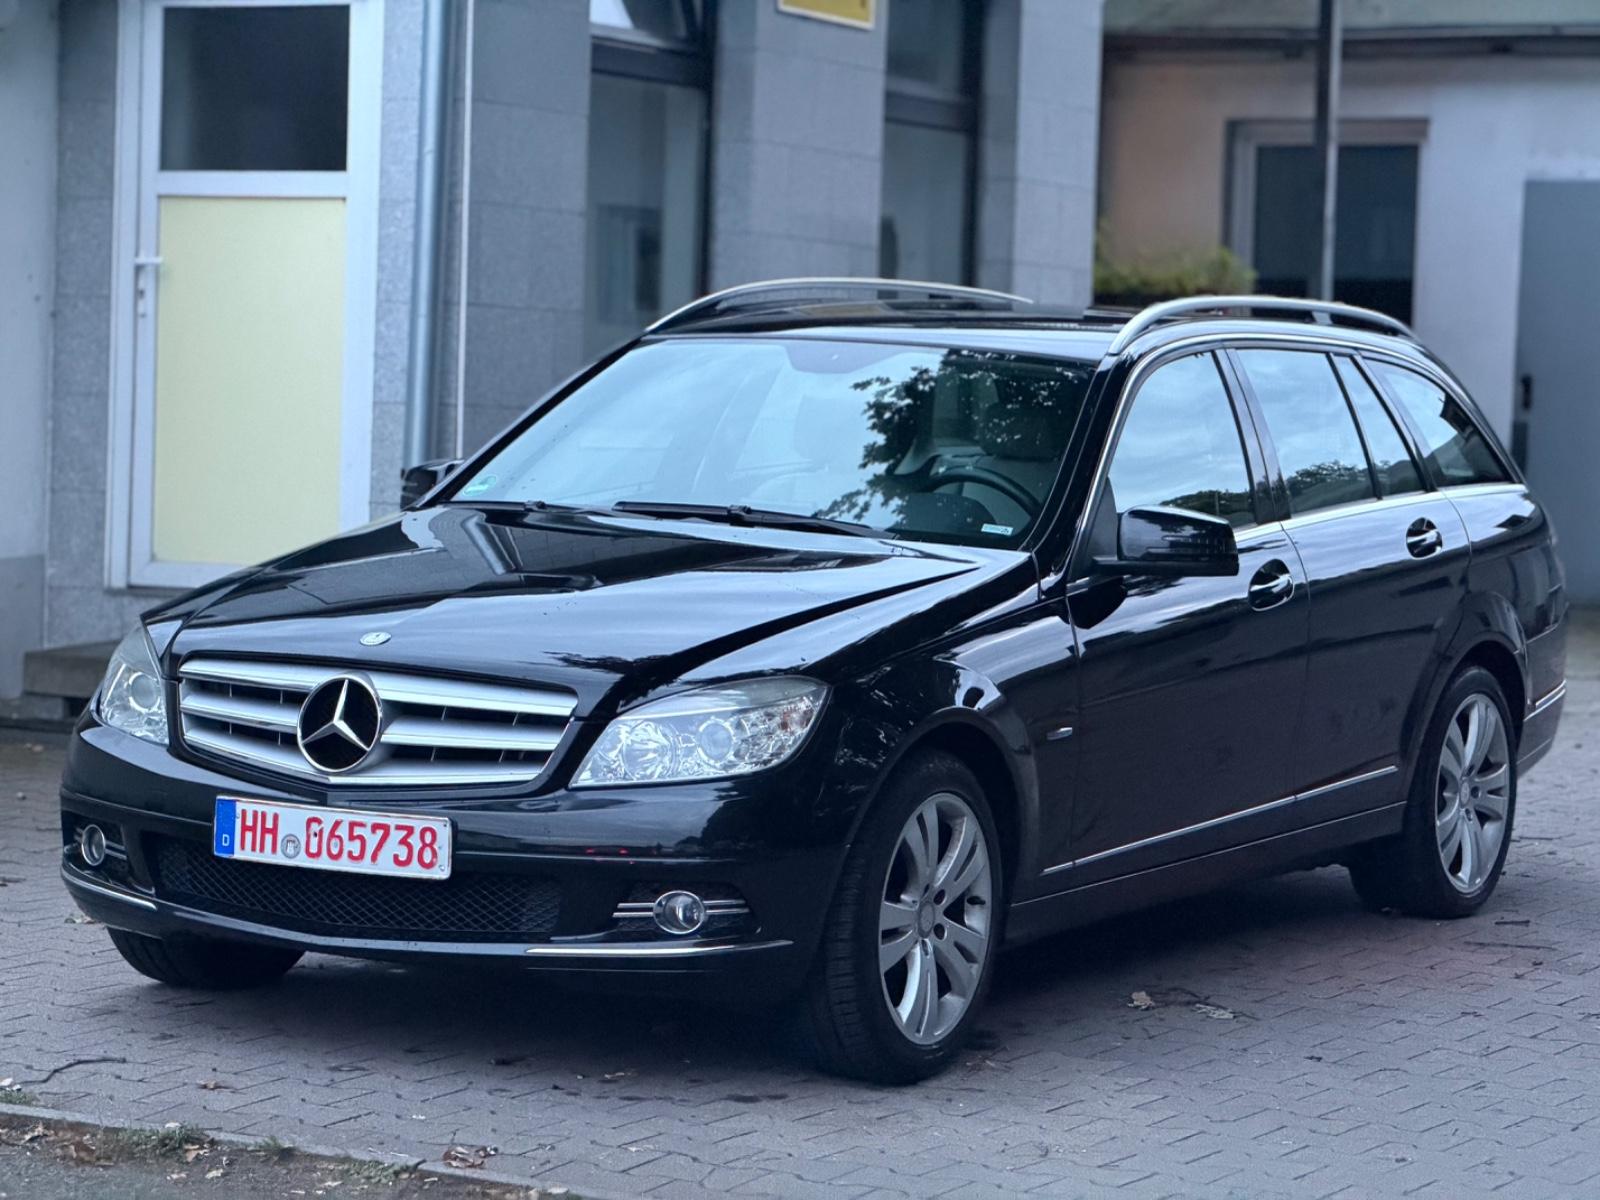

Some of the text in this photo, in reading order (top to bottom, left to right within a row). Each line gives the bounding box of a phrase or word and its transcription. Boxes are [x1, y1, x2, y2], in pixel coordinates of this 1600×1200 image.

[222, 834, 230, 846] D
[240, 808, 438, 869] HH 065738
